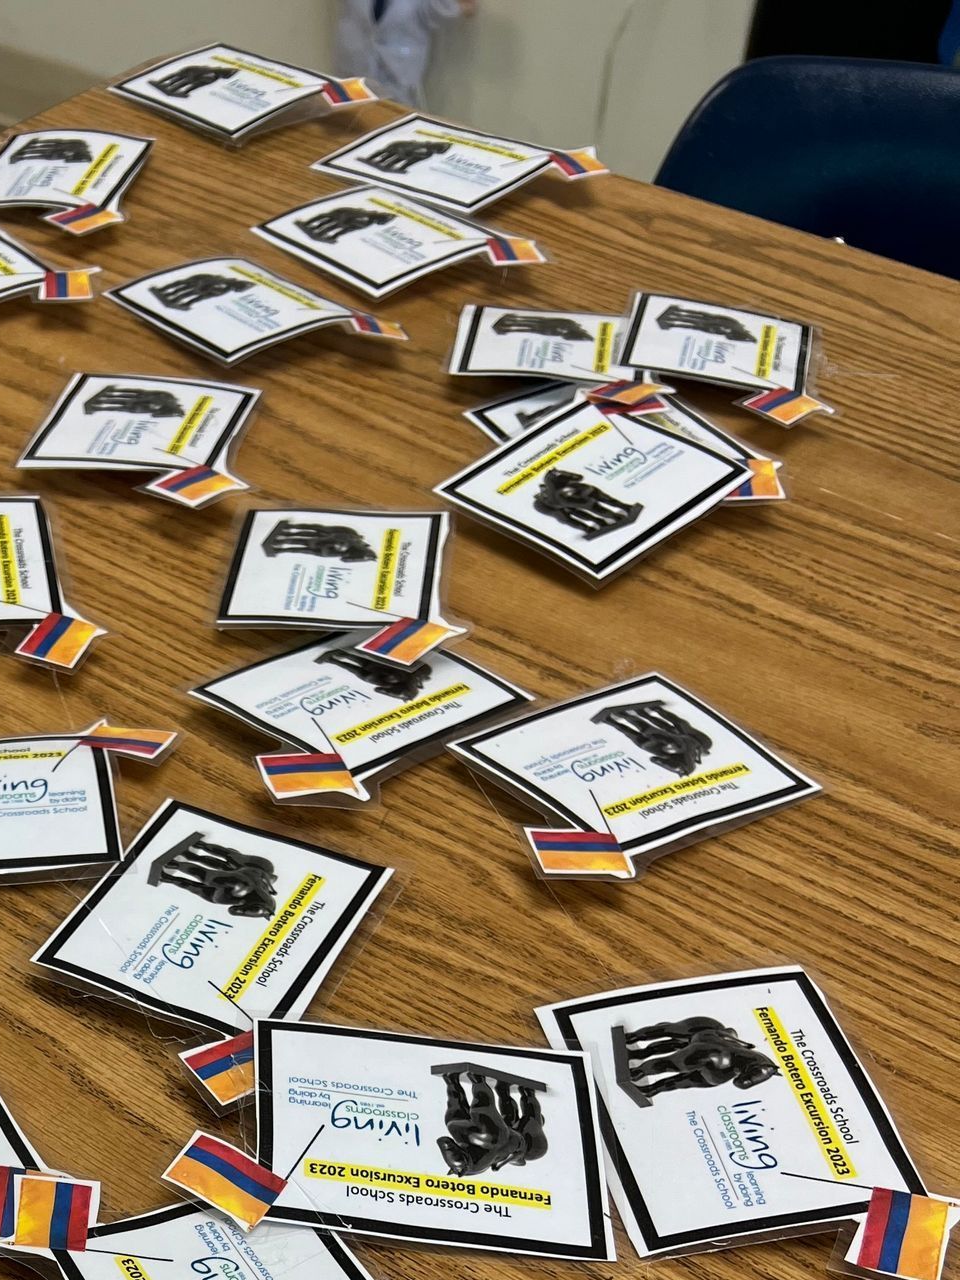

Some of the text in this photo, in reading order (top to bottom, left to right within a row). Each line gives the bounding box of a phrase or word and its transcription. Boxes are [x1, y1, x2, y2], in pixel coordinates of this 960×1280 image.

[583, 445, 648, 477] living
[296, 688, 372, 715] living
[570, 755, 646, 784] living
[159, 917, 235, 971] living
[222, 873, 322, 1000] Fernando Botero Excursion 2023
[255, 900, 325, 988] The Crossroads School
[288, 1087, 319, 1099] doing
[288, 1096, 331, 1109] learning
[289, 1076, 417, 1099] The Crossroads School
[756, 1005, 852, 1177] Fernando Botero Excursion 2023
[790, 1027, 861, 1144] The Crossroads School
[330, 1098, 421, 1147] living
[344, 1104, 419, 1122] classrooms
[716, 1105, 749, 1161] classrooms
[729, 1099, 781, 1170] living
[685, 1110, 737, 1209] The Crossroads School
[308, 1162, 552, 1205] Fernando Botero Excursion 2023
[344, 1185, 513, 1219] The Crossroads School
[737, 1181, 754, 1207] doing
[745, 1170, 766, 1205] learning
